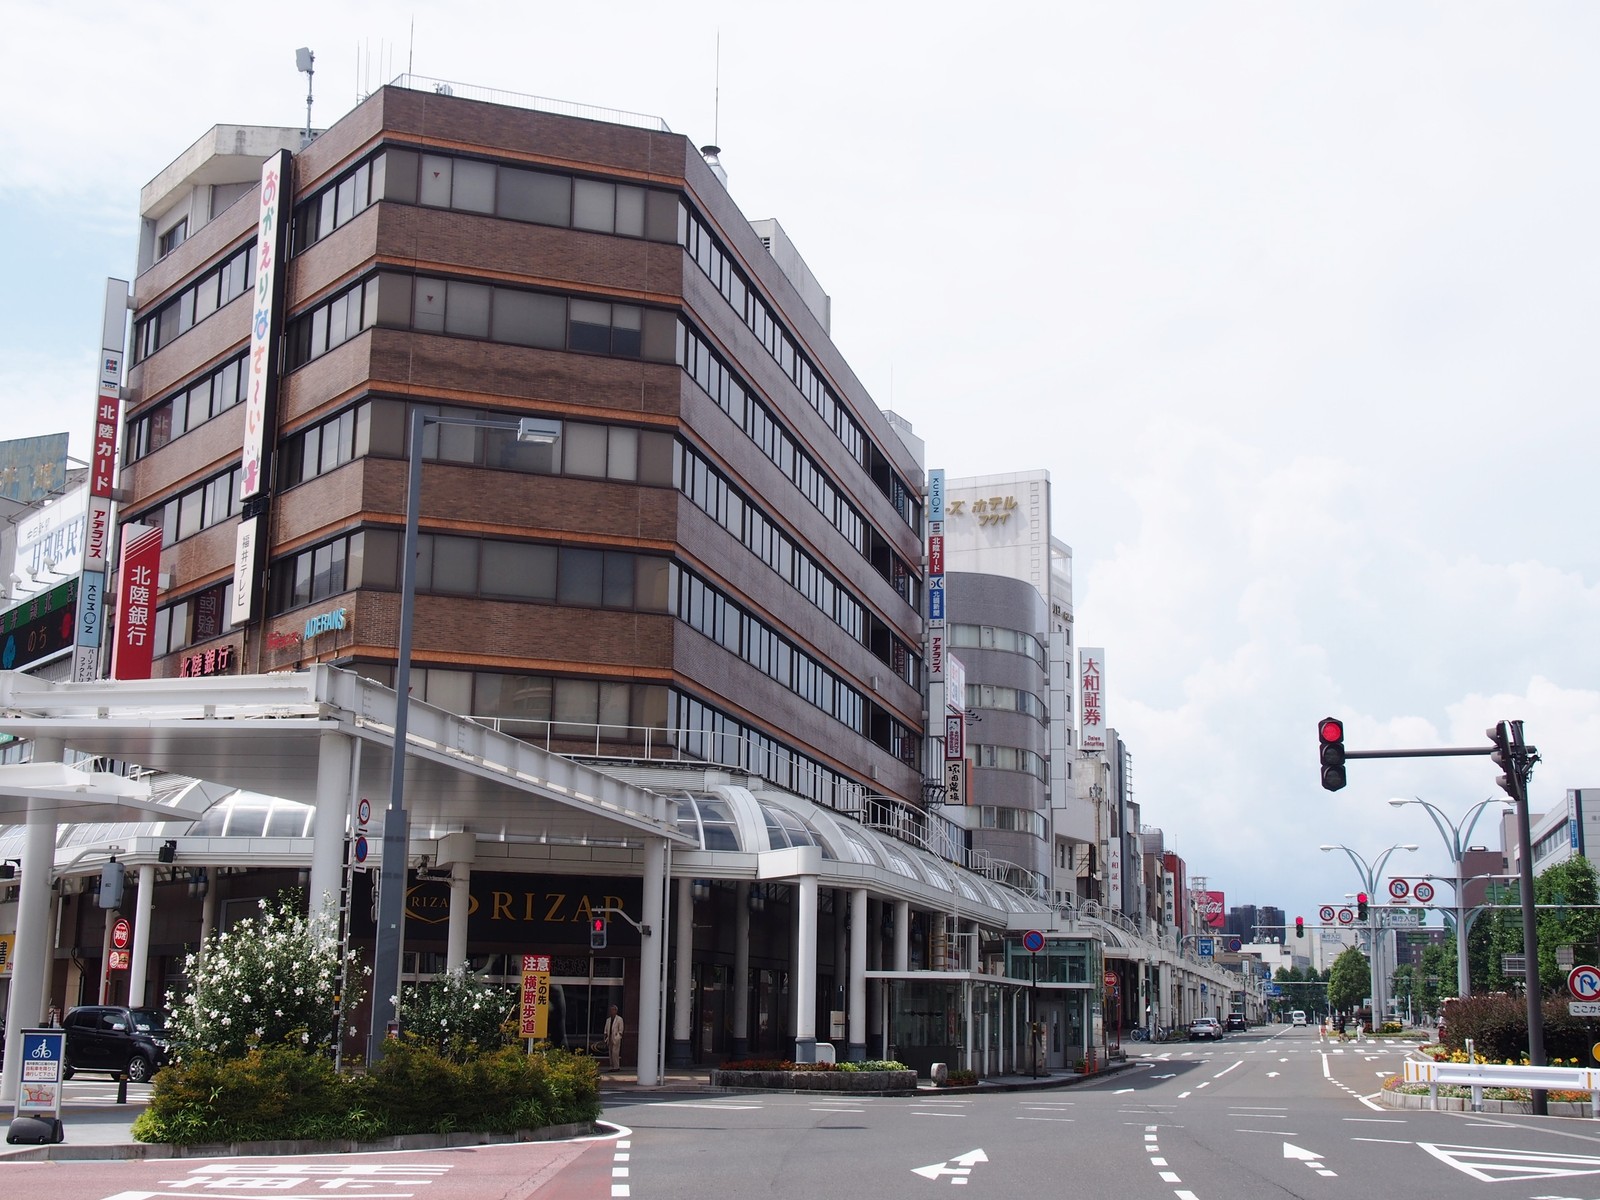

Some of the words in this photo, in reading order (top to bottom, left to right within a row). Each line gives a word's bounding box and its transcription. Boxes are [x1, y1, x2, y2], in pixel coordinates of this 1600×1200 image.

[96, 404, 116, 493] 北陸カード
[932, 478, 941, 513] KUMON
[971, 495, 1018, 514] ホテル
[89, 509, 106, 559] アデランス
[978, 513, 1011, 527] フクイ
[84, 584, 97, 635] KUMON
[126, 565, 151, 646] 北陸銀行
[27, 625, 48, 652] のち
[303, 607, 347, 641] ADERANS
[931, 637, 942, 674] アデランス
[1083, 657, 1101, 726] 大和証券
[361, 805, 368, 818] 40
[1111, 850, 1119, 892] 大和証券
[411, 896, 449, 909] RIZA
[491, 890, 625, 924] RIZAP
[1418, 887, 1430, 898] 50
[1342, 912, 1350, 920] 50
[522, 956, 550, 972] 注意
[521, 975, 538, 1035] 横断歩道
[537, 975, 548, 1006] この先
[1573, 1005, 1600, 1014] ここか
